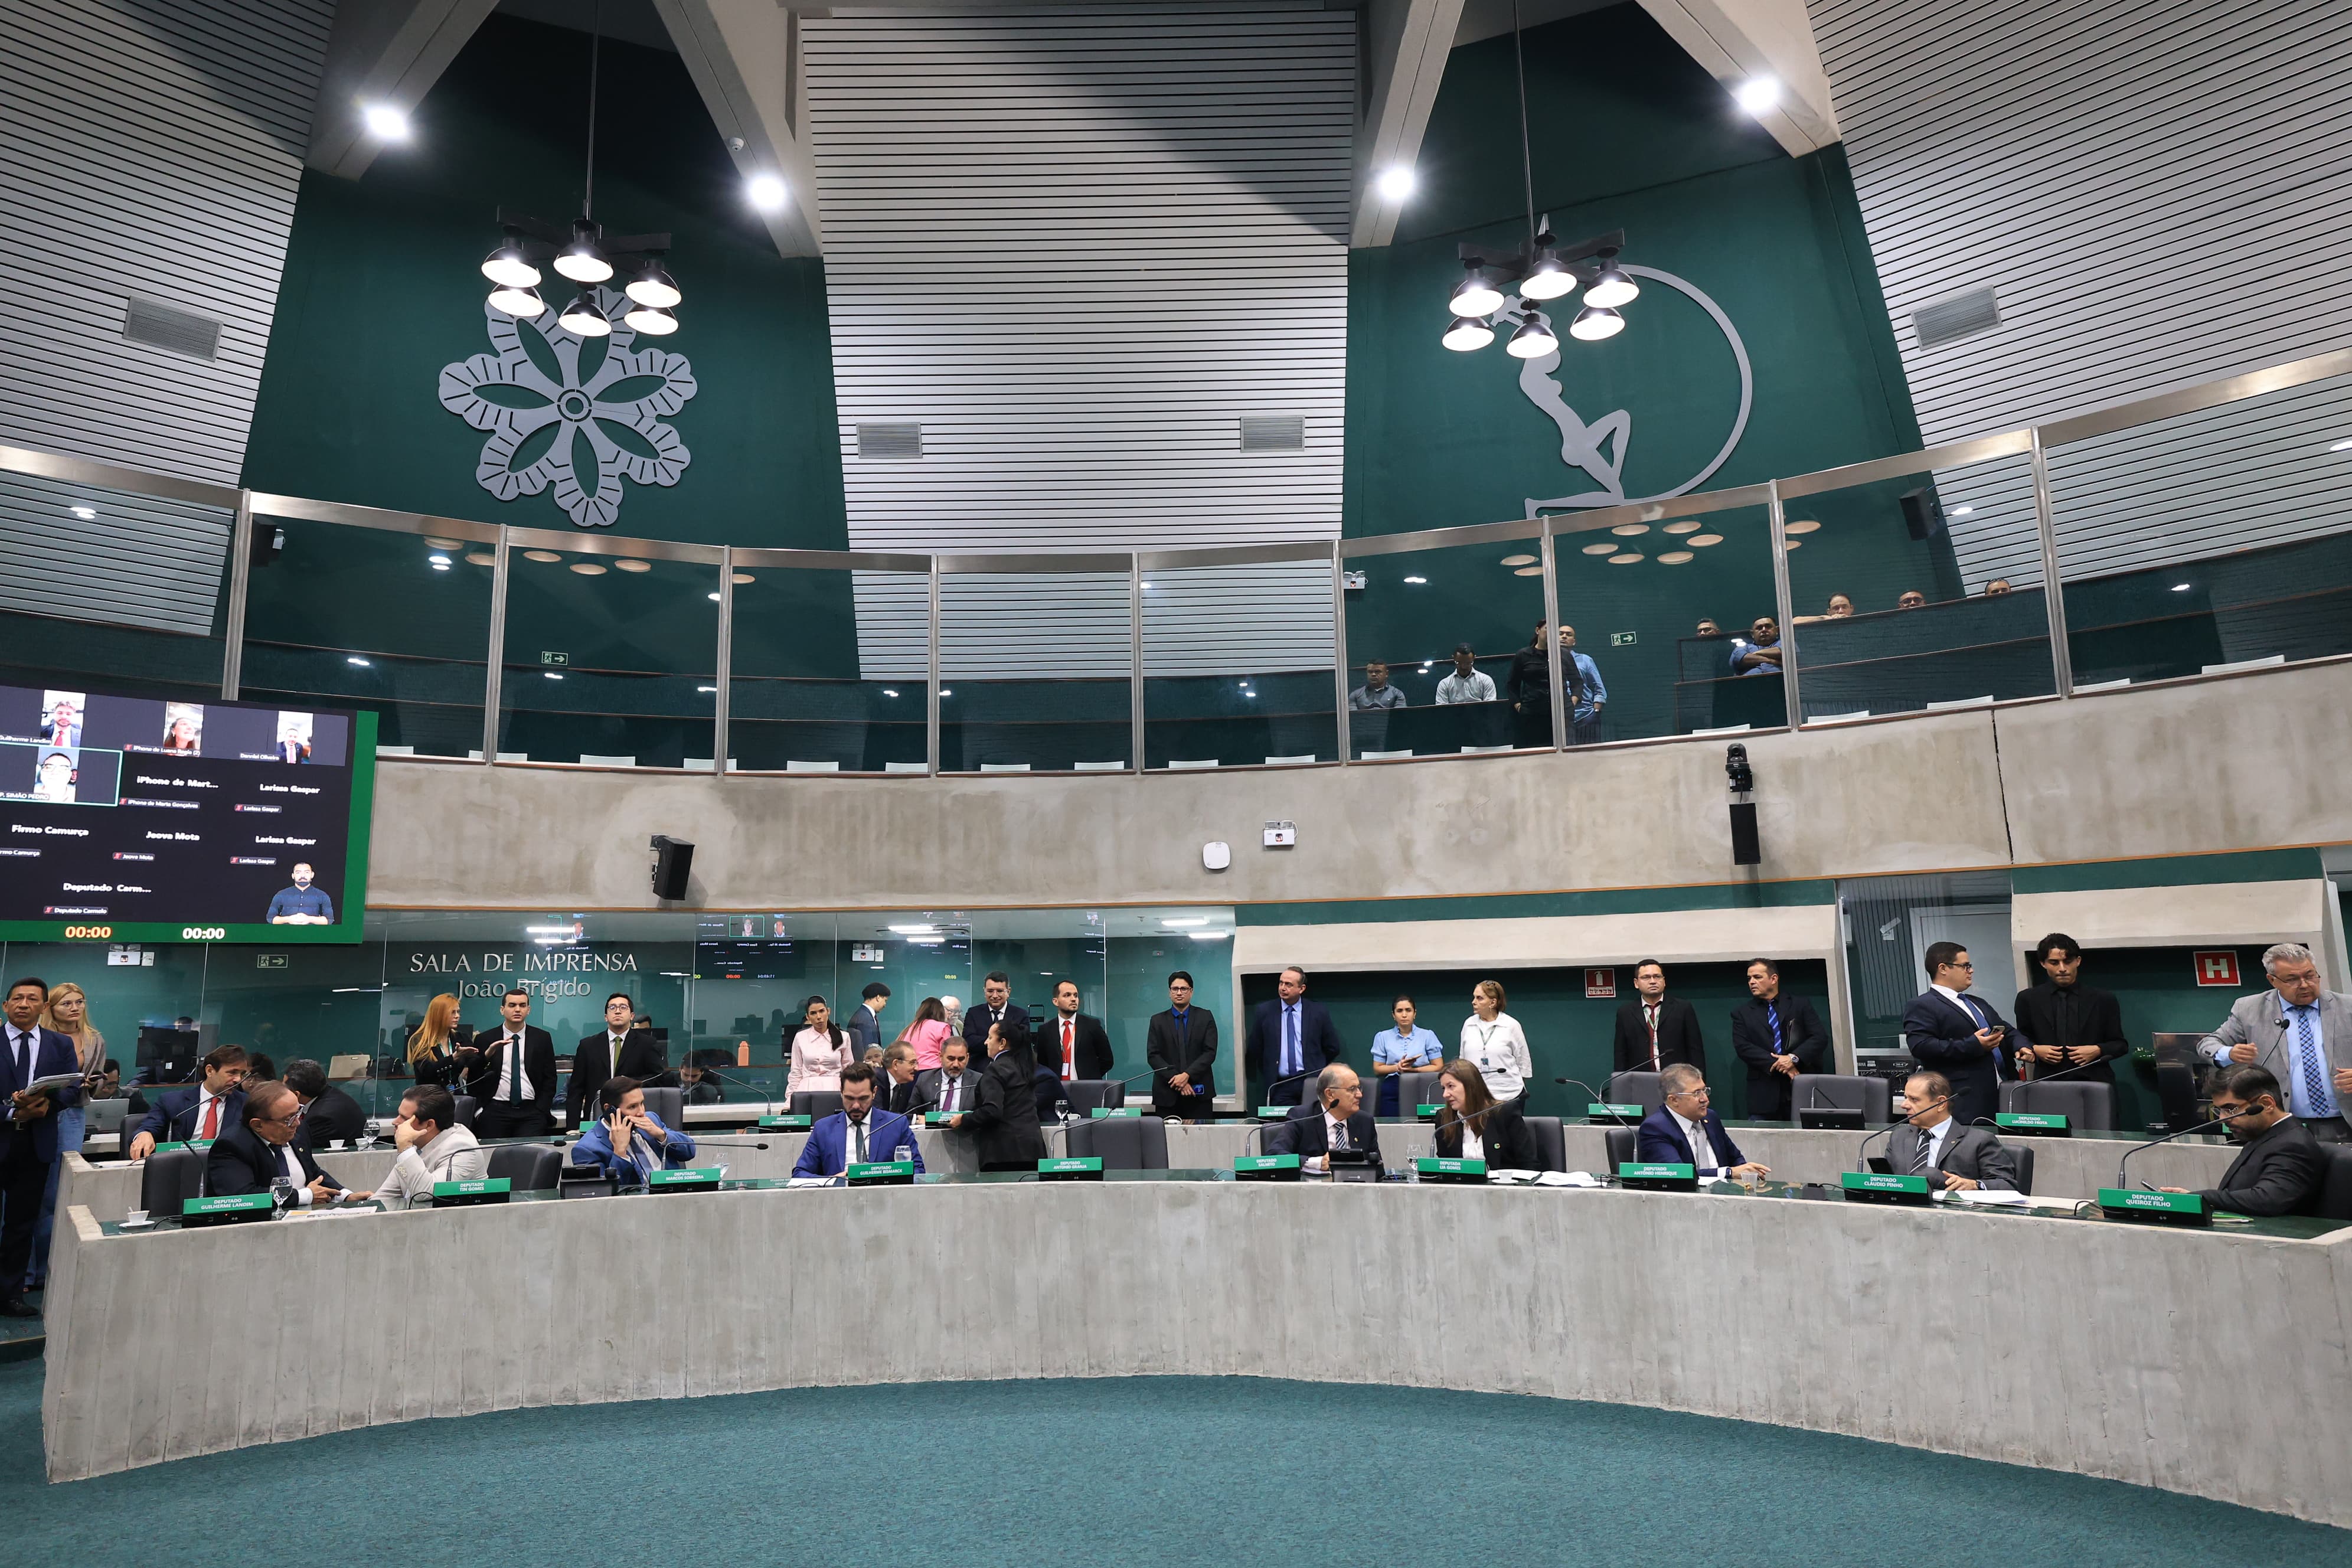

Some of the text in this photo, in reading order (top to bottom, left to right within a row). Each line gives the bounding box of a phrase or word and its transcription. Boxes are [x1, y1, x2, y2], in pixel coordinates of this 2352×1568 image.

[137, 776, 170, 785] iPhone
[172, 778, 185, 786] de
[290, 785, 321, 795] Gaspar
[12, 825, 89, 837] Firmo Camurça
[146, 831, 200, 841] Jeova Mota
[256, 835, 316, 845] Larissa Gaspar
[63, 883, 113, 893] Deputado
[65, 926, 112, 938] 00:00
[182, 927, 225, 939] 00:00
[410, 952, 638, 972] SALA DE IMPRENSA
[2205, 958, 2229, 978] H
[458, 976, 591, 1004] João Brígido
